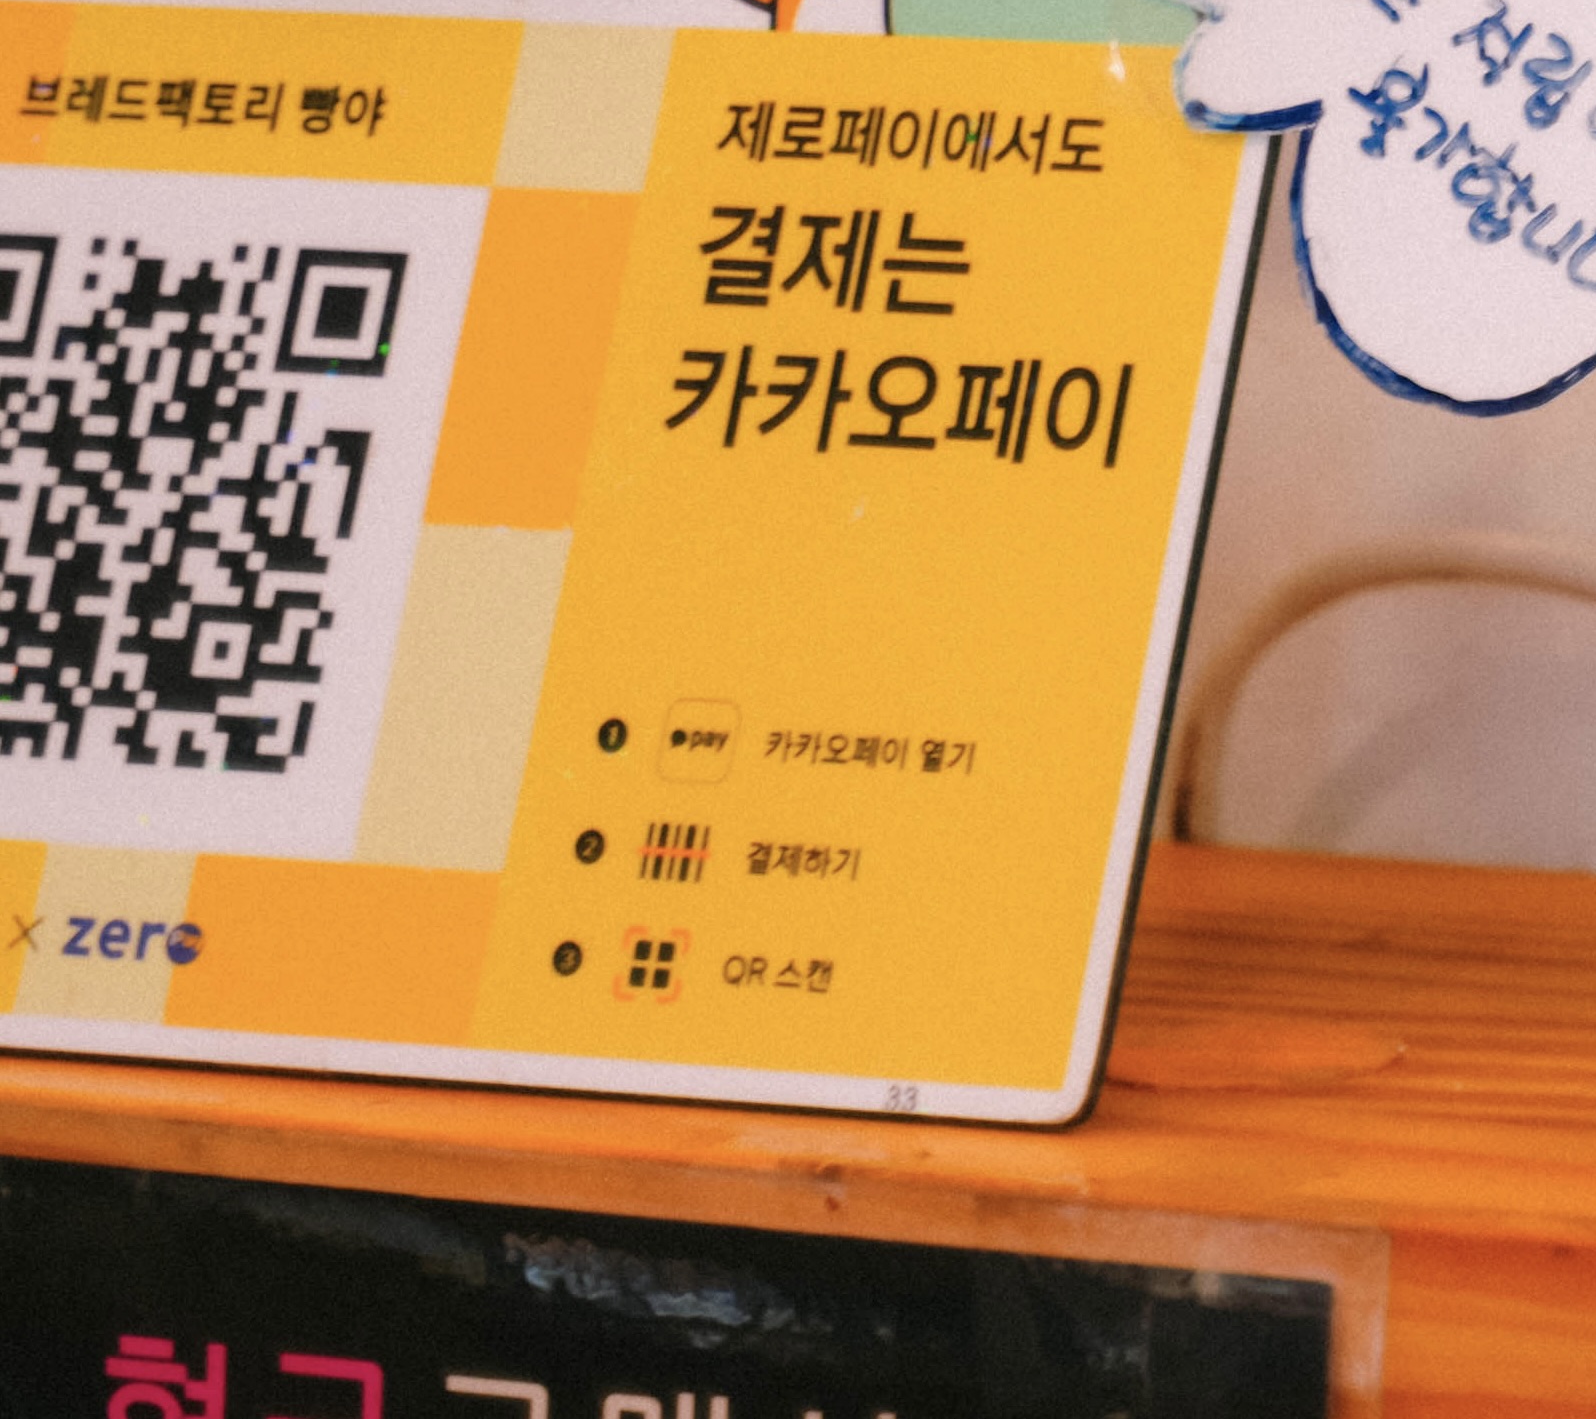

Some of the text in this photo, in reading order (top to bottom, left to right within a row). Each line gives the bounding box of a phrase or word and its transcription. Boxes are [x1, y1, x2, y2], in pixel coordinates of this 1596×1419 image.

[19, 73, 388, 138] 브레드팩토리 빵야
[716, 98, 1106, 177] 제로페이에서도
[699, 204, 973, 318] 결제는
[665, 344, 1134, 470] 카카오페이
[688, 728, 729, 754] pay
[763, 730, 909, 770] 카카오페이
[920, 738, 978, 776] 열기
[746, 840, 862, 881] 결제하기
[722, 955, 766, 988] QR
[772, 958, 834, 994] 스캔
